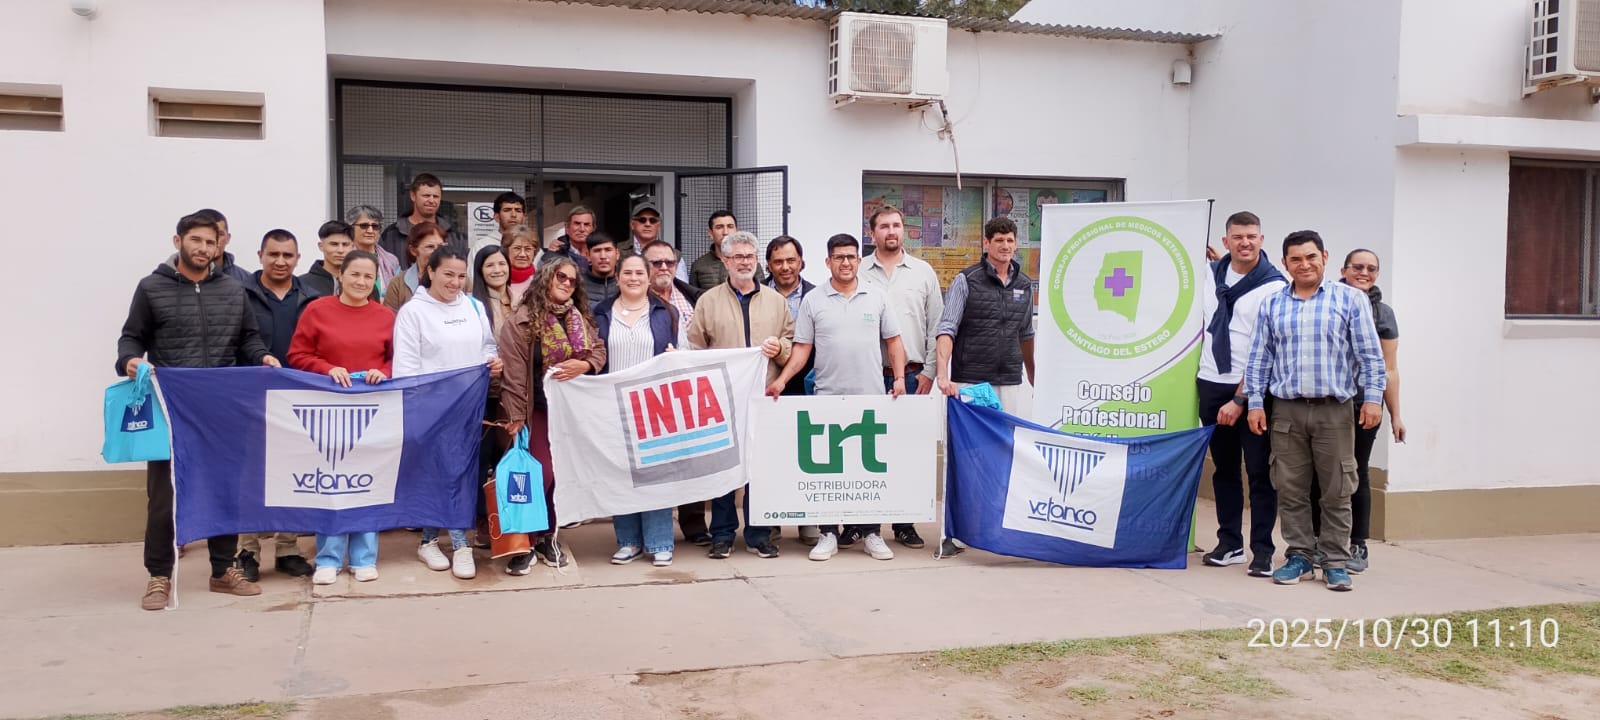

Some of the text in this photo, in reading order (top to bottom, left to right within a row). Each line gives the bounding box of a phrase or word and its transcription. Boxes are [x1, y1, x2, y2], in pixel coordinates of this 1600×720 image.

[1054, 254, 1069, 290] CONSEJO
[1068, 223, 1115, 255] PROFESIONAL
[1115, 221, 1127, 229] DE
[1161, 236, 1190, 290] VETERINARIOS
[1066, 327, 1171, 356] SANTIAGO DEL ESTERO
[1077, 380, 1152, 404] Consejo
[629, 375, 725, 441] INTA
[1061, 406, 1167, 430] Profesional
[797, 409, 887, 474] trt
[292, 467, 374, 494] vetanco
[798, 480, 887, 491] DISTRIBUIDORA
[805, 491, 881, 502] VETERINARIA
[1028, 496, 1097, 526] vetanco
